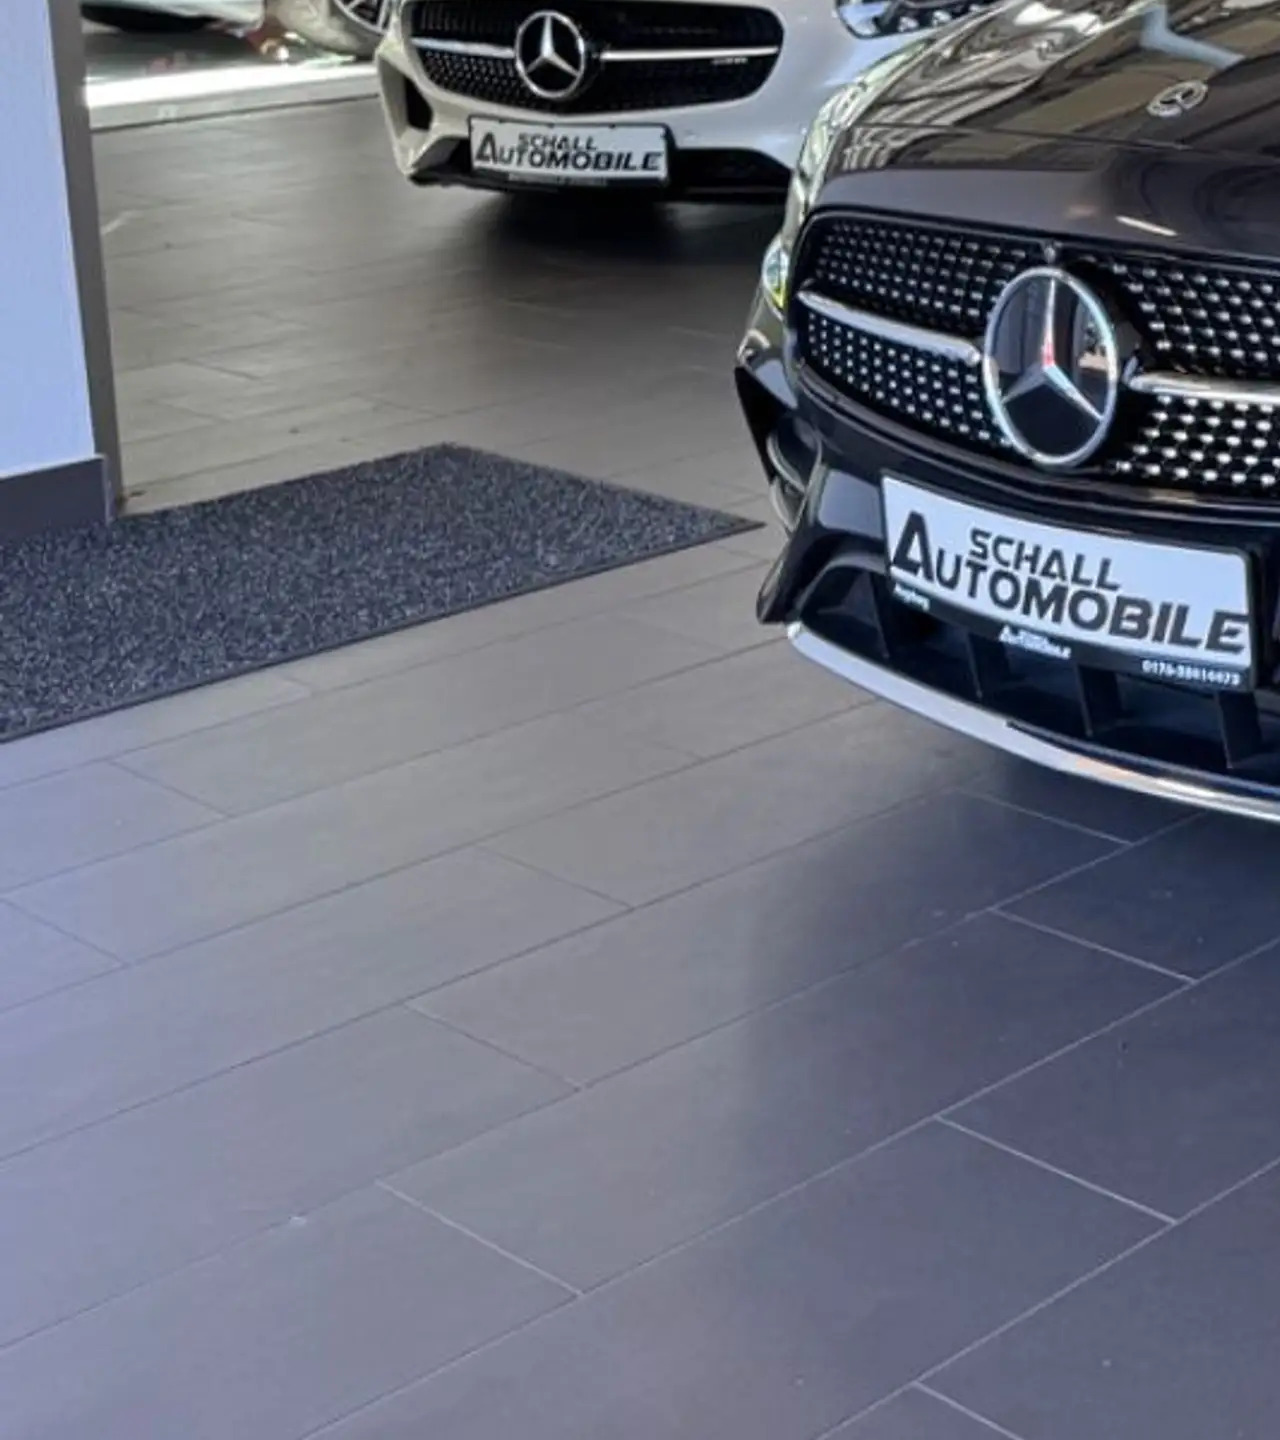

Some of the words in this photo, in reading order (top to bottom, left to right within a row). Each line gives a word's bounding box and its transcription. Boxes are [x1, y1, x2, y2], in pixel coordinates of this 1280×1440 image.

[476, 132, 663, 171] AUTOMOBILE
[519, 133, 597, 151] SCHALL
[893, 511, 1249, 653] AUTOMOBILE
[969, 527, 1121, 591] SCHALL
